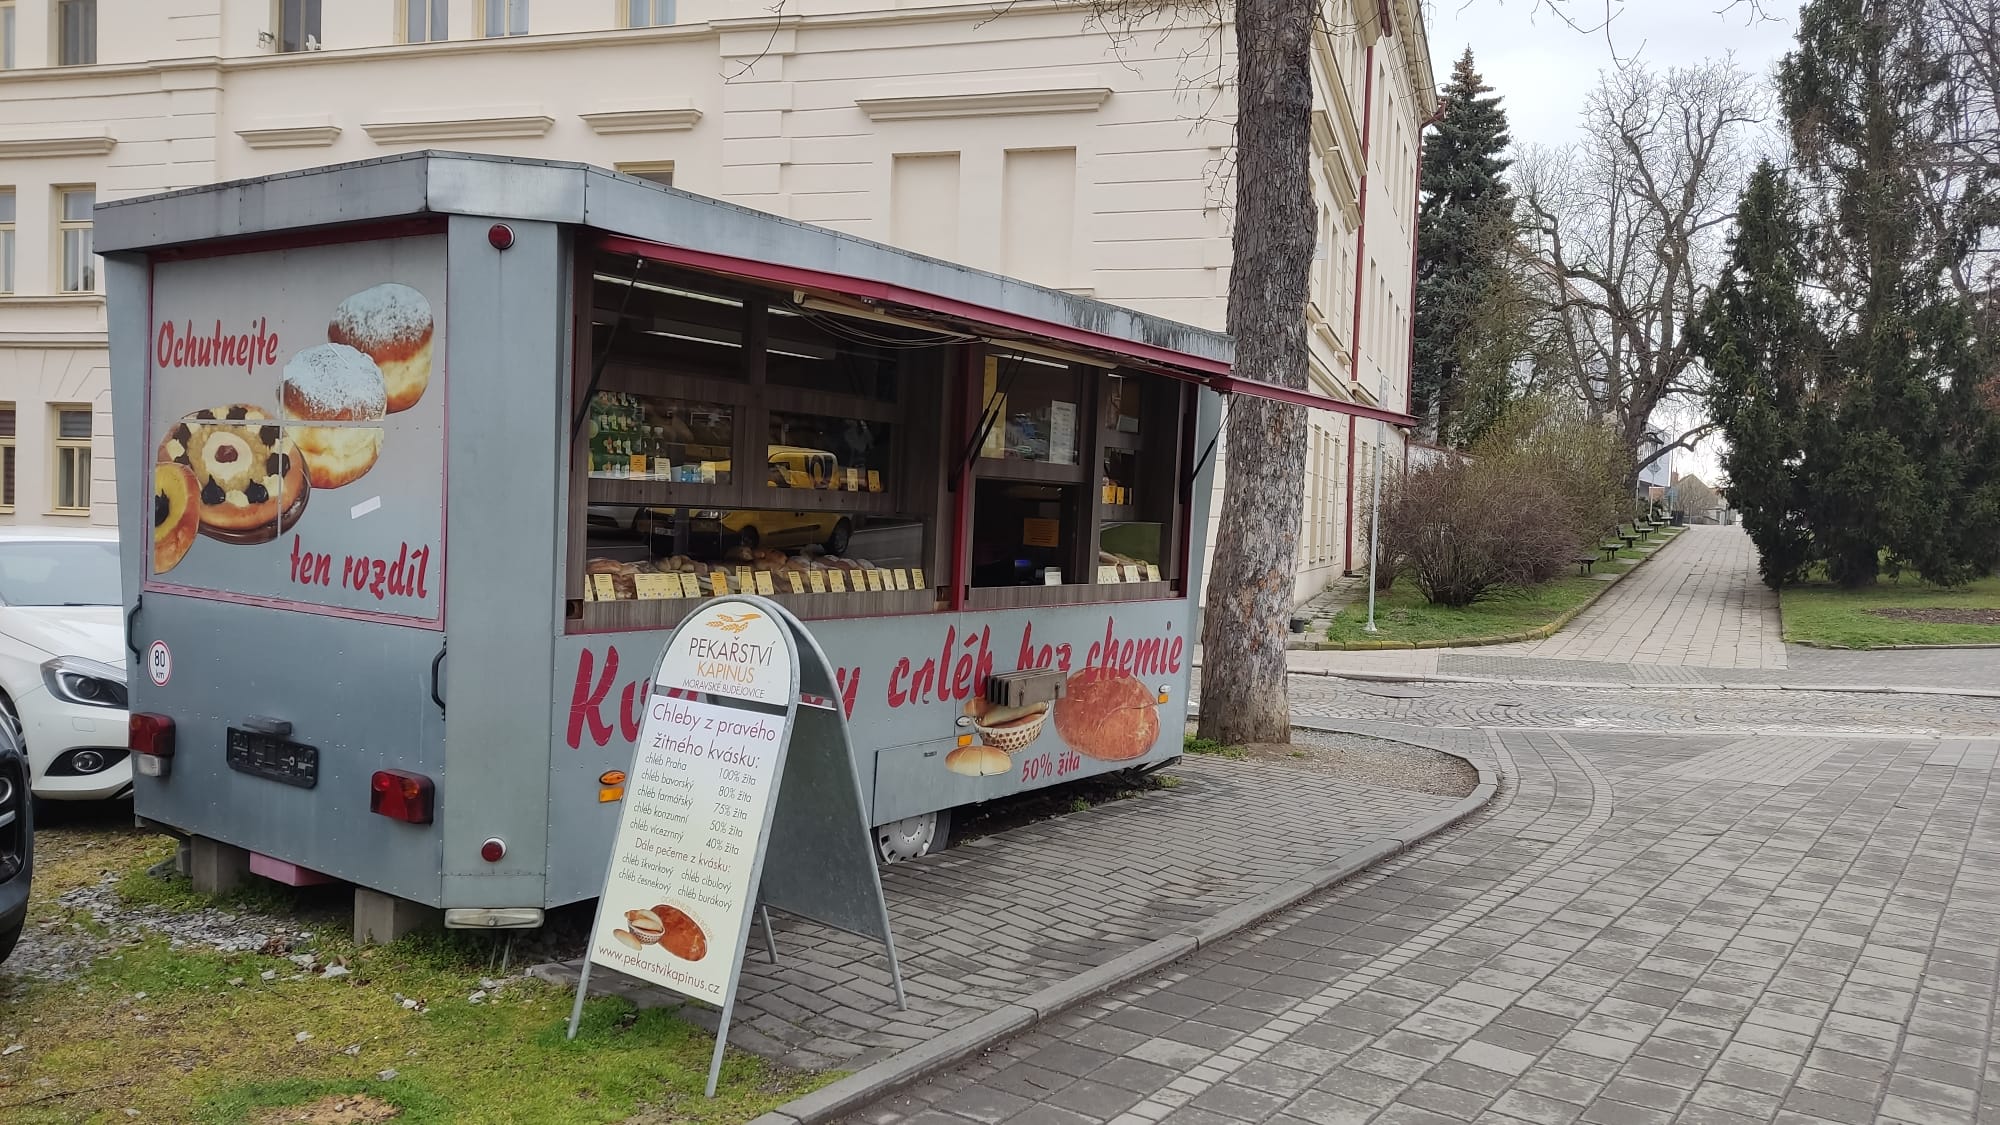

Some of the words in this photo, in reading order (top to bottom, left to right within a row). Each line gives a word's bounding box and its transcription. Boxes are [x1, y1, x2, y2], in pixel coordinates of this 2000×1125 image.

[157, 317, 278, 375] Ochutnejte
[290, 534, 330, 586] ten
[343, 542, 429, 600] rozdíl
[154, 650, 166, 668] 80
[688, 636, 776, 666] PEKAŘSTVÍ
[1085, 616, 1183, 683] chemie
[156, 670, 165, 679] km
[697, 661, 755, 683] KAPINUS
[682, 679, 721, 692] MORAVSKÉ
[653, 702, 701, 731] Chleby
[704, 718, 714, 729] z
[716, 720, 776, 741] pravého
[645, 752, 663, 766] chléb
[665, 757, 687, 771] Praha
[653, 732, 703, 756] žitného
[708, 740, 760, 768] kvásku:
[641, 768, 659, 782] chléb
[661, 773, 694, 792] bavorský
[719, 768, 739, 782] 100%
[742, 773, 756, 785] žita
[1022, 757, 1053, 783] 50%
[1057, 751, 1081, 776] žita
[637, 785, 655, 799] chléb
[657, 789, 694, 810] farmářský
[718, 786, 735, 799] 80%
[737, 791, 752, 803] žita
[634, 801, 652, 815] chléb
[654, 805, 689, 824] konzumní
[713, 803, 731, 816] 75%
[733, 808, 747, 820] žita
[630, 818, 648, 832] chléb
[650, 823, 684, 844] vícezrnný
[709, 820, 727, 834] 50%
[728, 826, 743, 838] žita
[635, 837, 654, 852] Dále
[655, 846, 688, 862] pečeme
[690, 855, 696, 863] z
[699, 852, 731, 873] kvásku:
[706, 838, 723, 851] 40%
[724, 843, 740, 855] žita
[622, 852, 640, 866] chléb
[640, 857, 674, 878] škvarkový
[618, 867, 636, 882] chléb
[638, 874, 671, 895] česnekový
[681, 868, 700, 883] chléb
[701, 875, 732, 895] cibulový
[677, 884, 697, 900] chléb
[698, 889, 732, 912] burákový
[598, 945, 721, 994] www.pekarstvikapinus.cz
